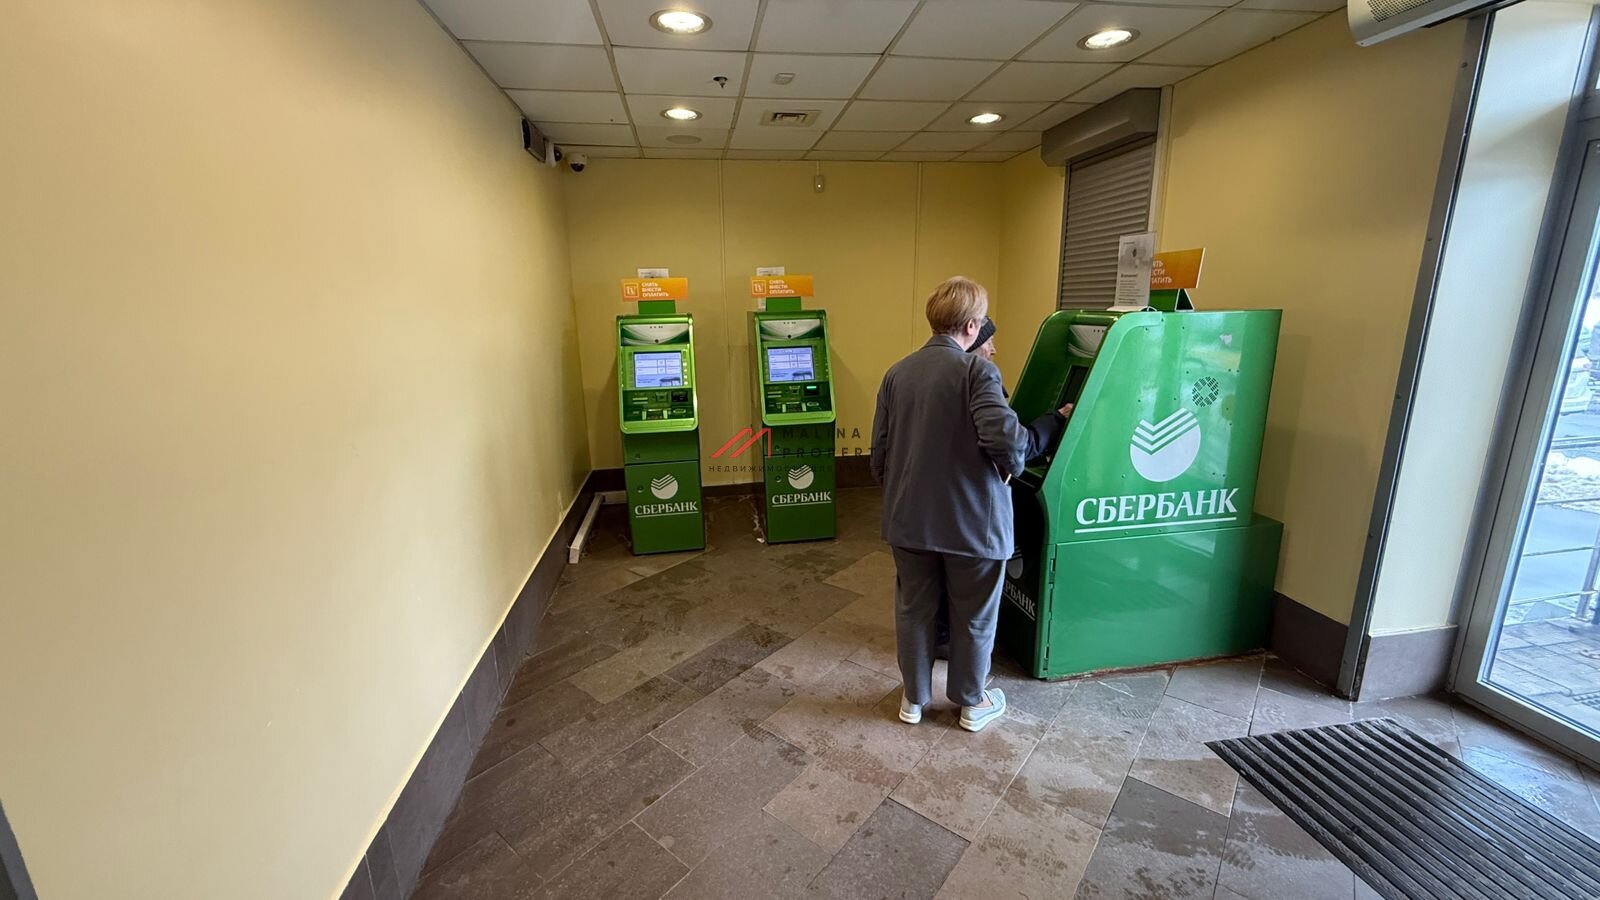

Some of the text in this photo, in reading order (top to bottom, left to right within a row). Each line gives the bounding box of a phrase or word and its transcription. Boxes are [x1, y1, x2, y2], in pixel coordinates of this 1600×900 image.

[772, 492, 832, 505] СБЕРБАНК
[634, 501, 698, 516] СБЕРБАНК
[1076, 488, 1239, 525] СБЕРБАНК
